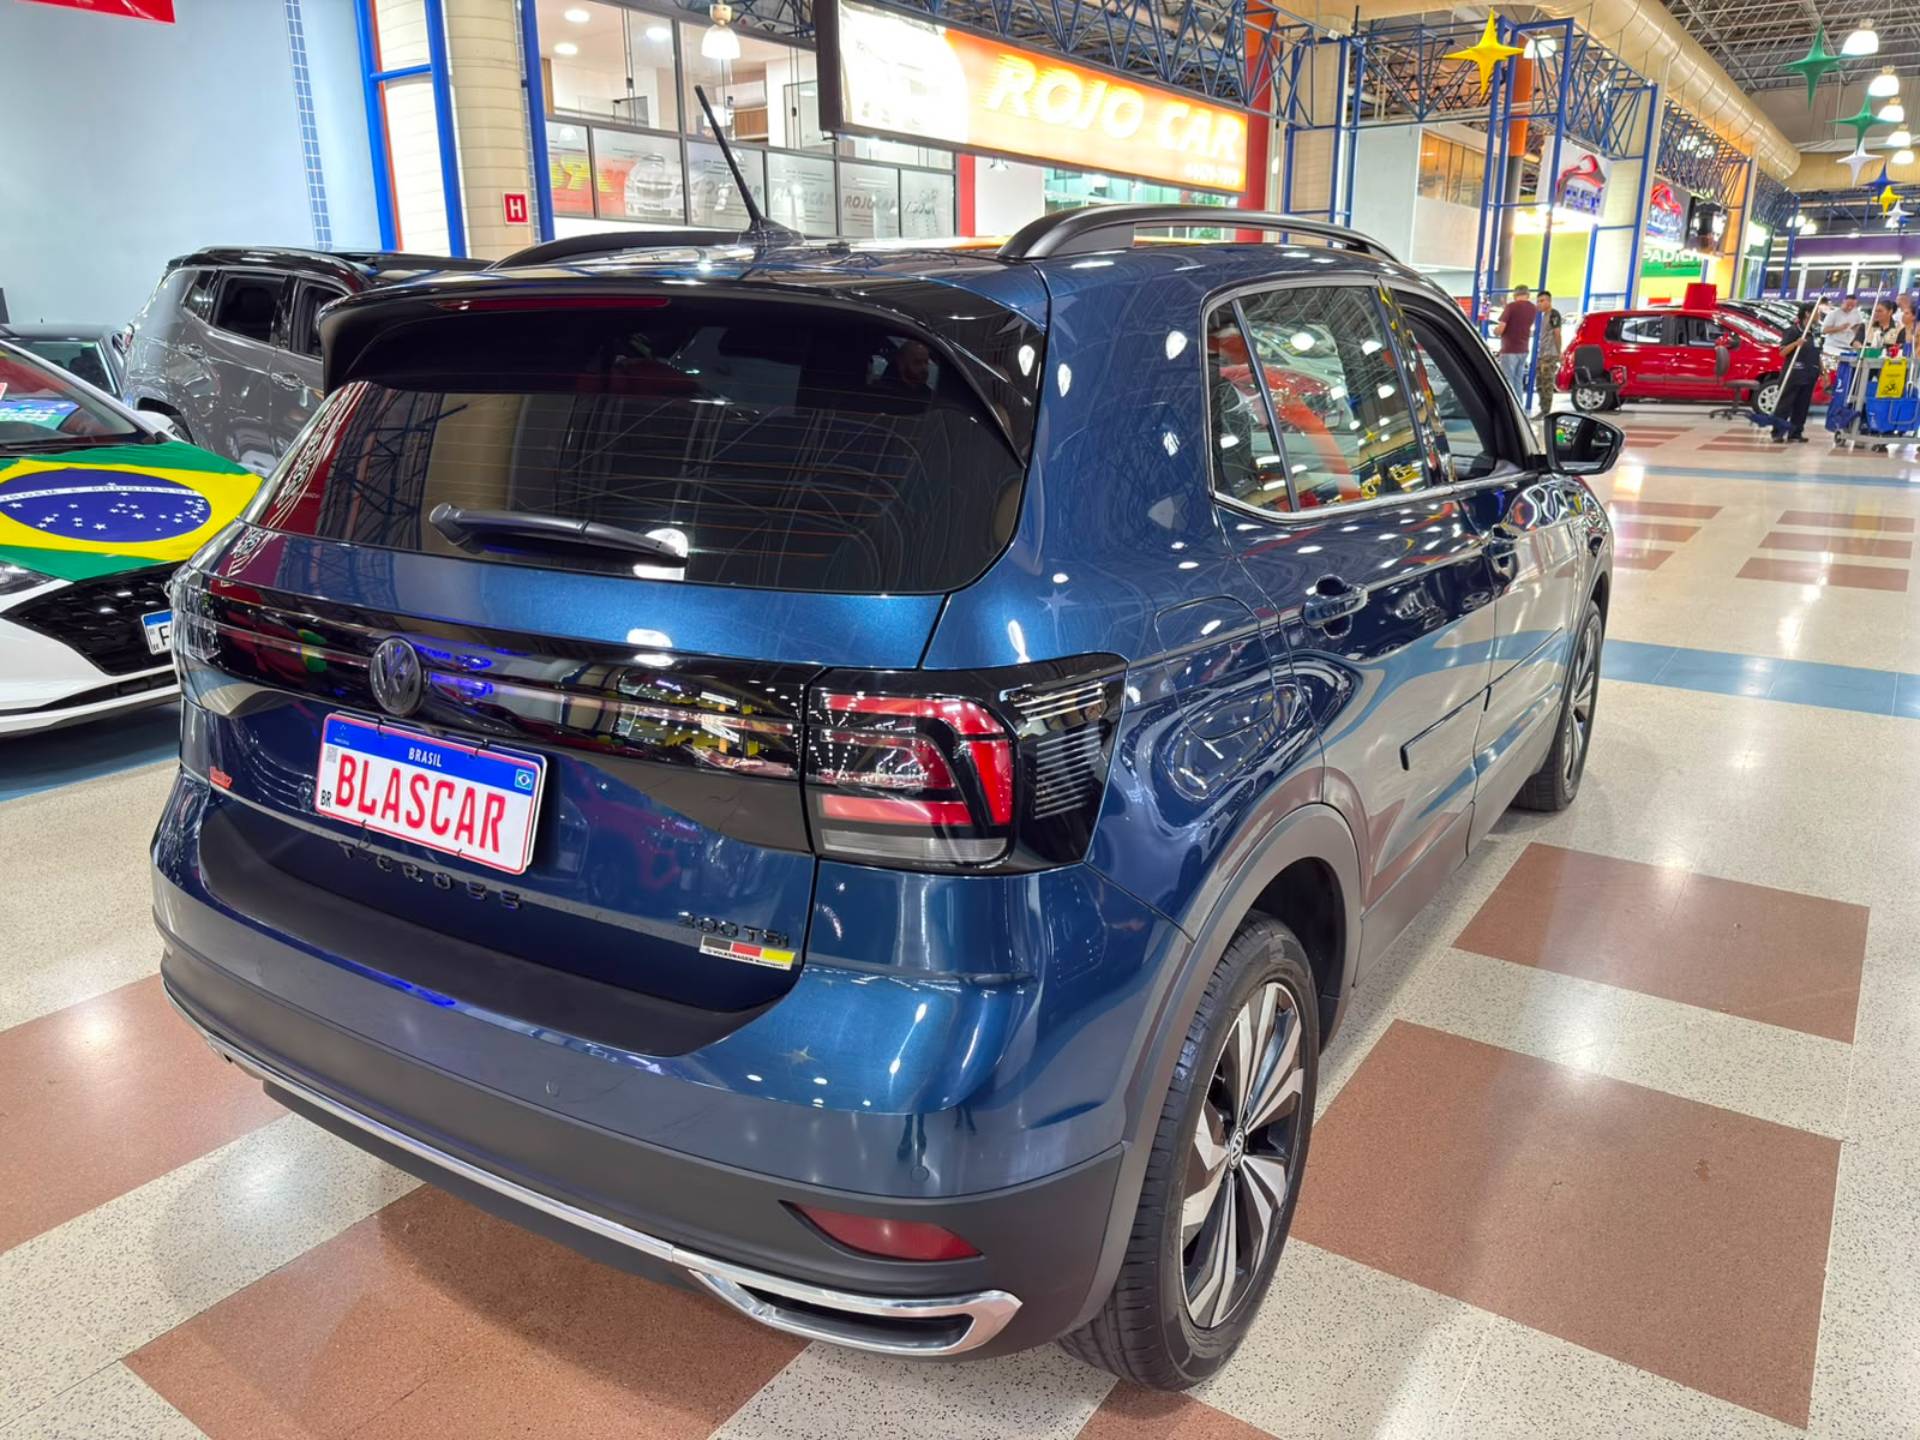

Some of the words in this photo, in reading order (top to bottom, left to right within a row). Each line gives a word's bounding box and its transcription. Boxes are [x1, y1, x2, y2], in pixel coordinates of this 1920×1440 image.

[985, 55, 1144, 139] ROJO
[1157, 100, 1242, 162] CAR
[509, 198, 522, 218] H
[407, 747, 442, 767] BRASIL
[320, 789, 332, 808] BR
[335, 754, 506, 854] BLASCAR
[677, 911, 739, 938] 200
